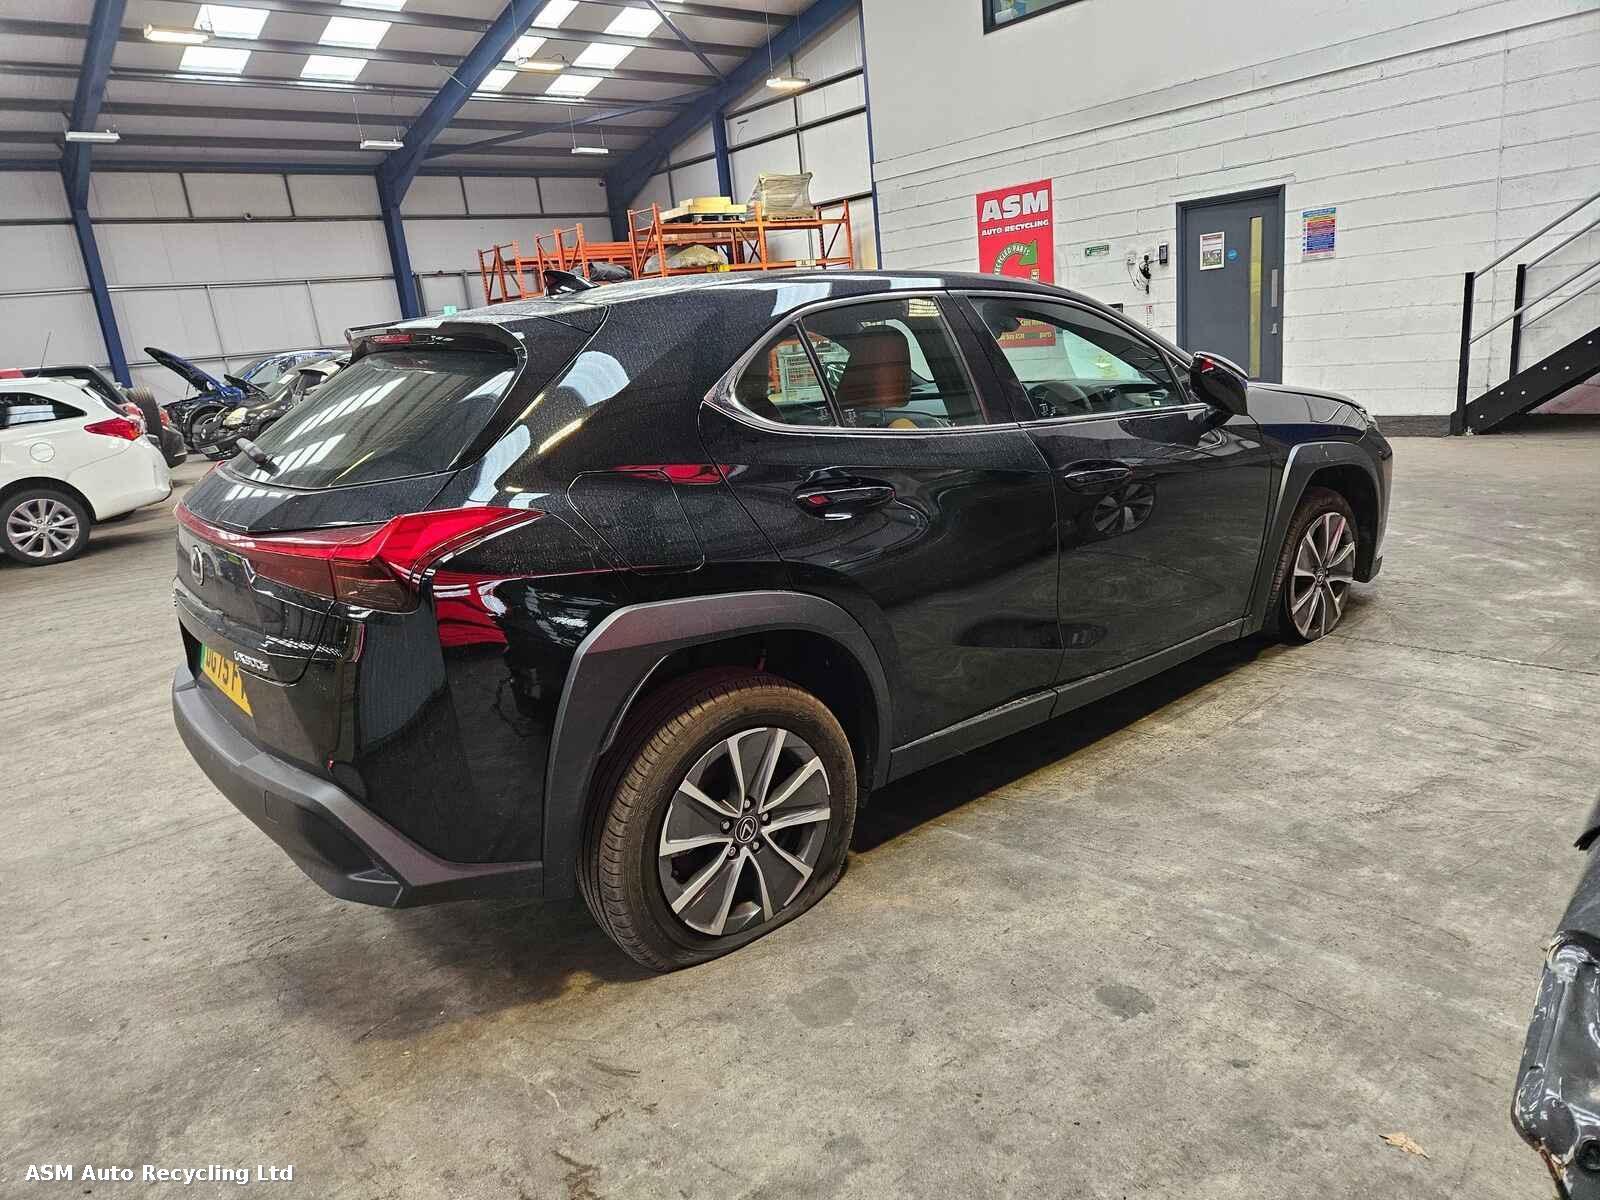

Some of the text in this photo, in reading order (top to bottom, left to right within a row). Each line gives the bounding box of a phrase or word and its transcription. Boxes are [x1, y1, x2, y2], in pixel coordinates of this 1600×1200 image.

[981, 189, 1049, 223] ASM
[982, 219, 1049, 236] AUTO RECYCLING
